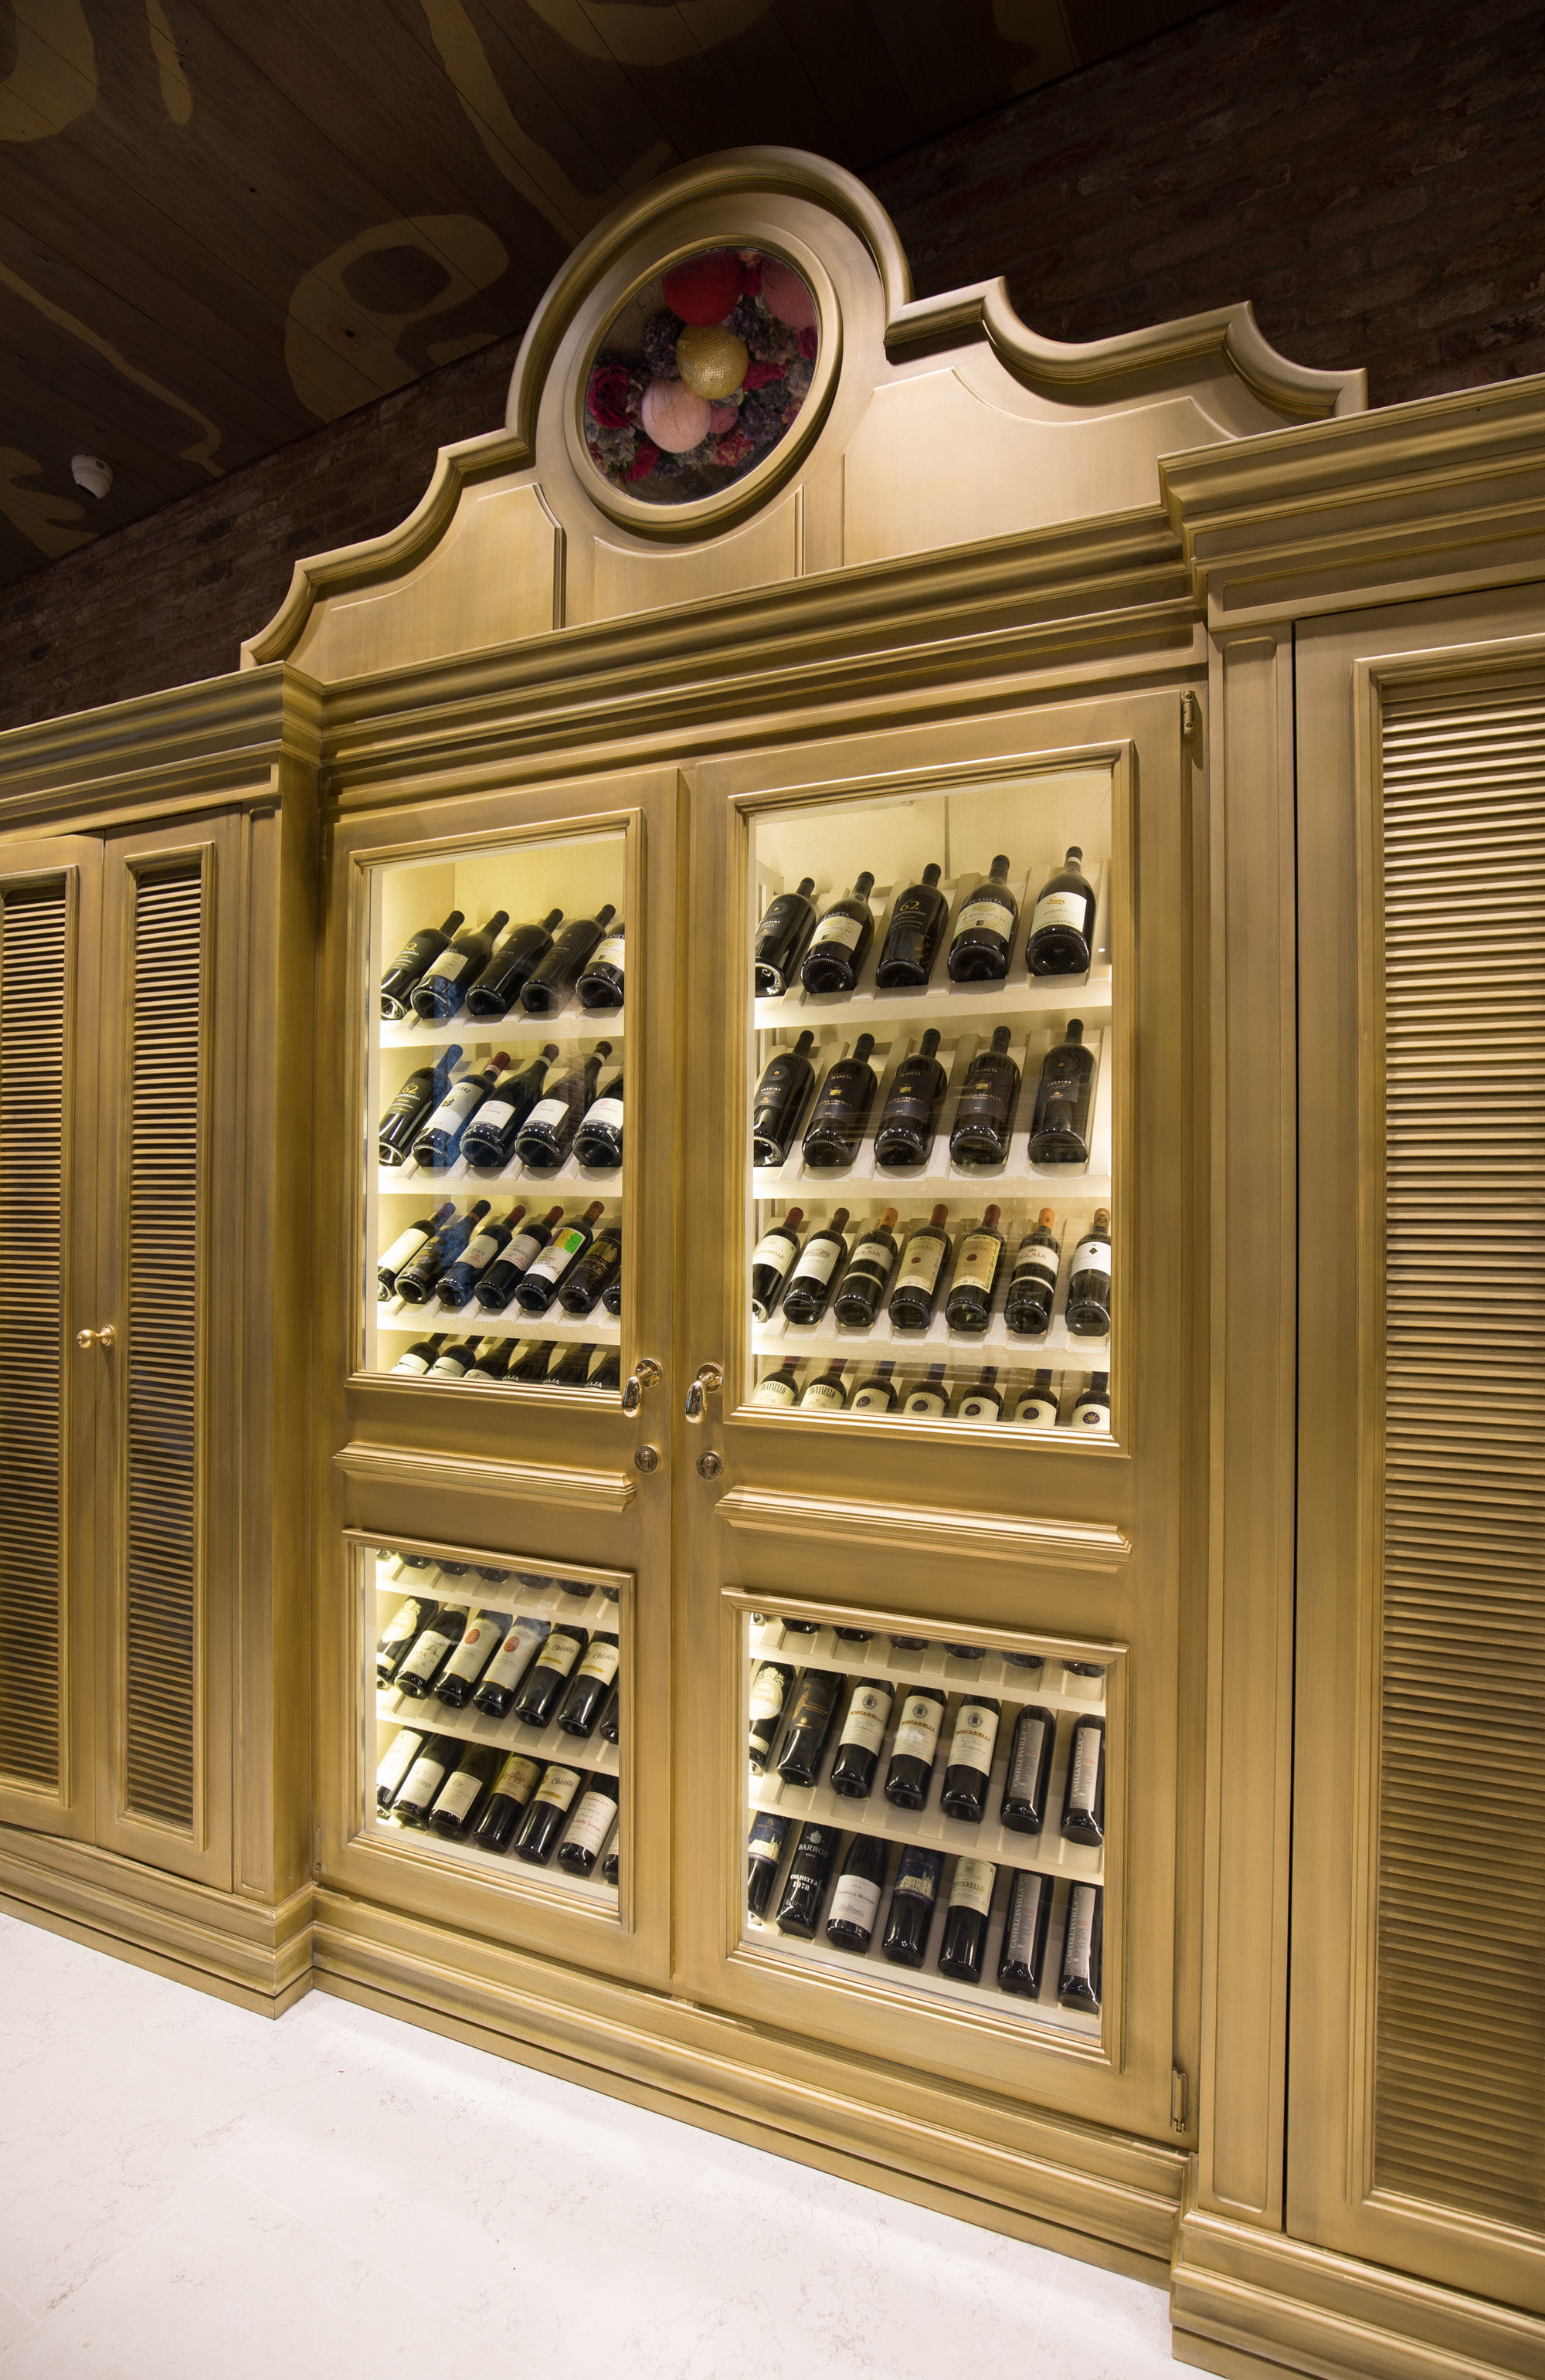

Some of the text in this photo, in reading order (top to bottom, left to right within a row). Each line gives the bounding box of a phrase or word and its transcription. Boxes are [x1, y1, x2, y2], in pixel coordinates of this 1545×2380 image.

[900, 898, 920, 912] 62
[401, 1082, 419, 1094] 62
[850, 1710, 884, 1723] BOSCARELLI
[901, 1720, 935, 1732] BOSCARELLI
[956, 1730, 991, 1742] BOSCARELLI
[797, 1843, 829, 1858] BARROS
[789, 1874, 818, 1886] COLHEITA
